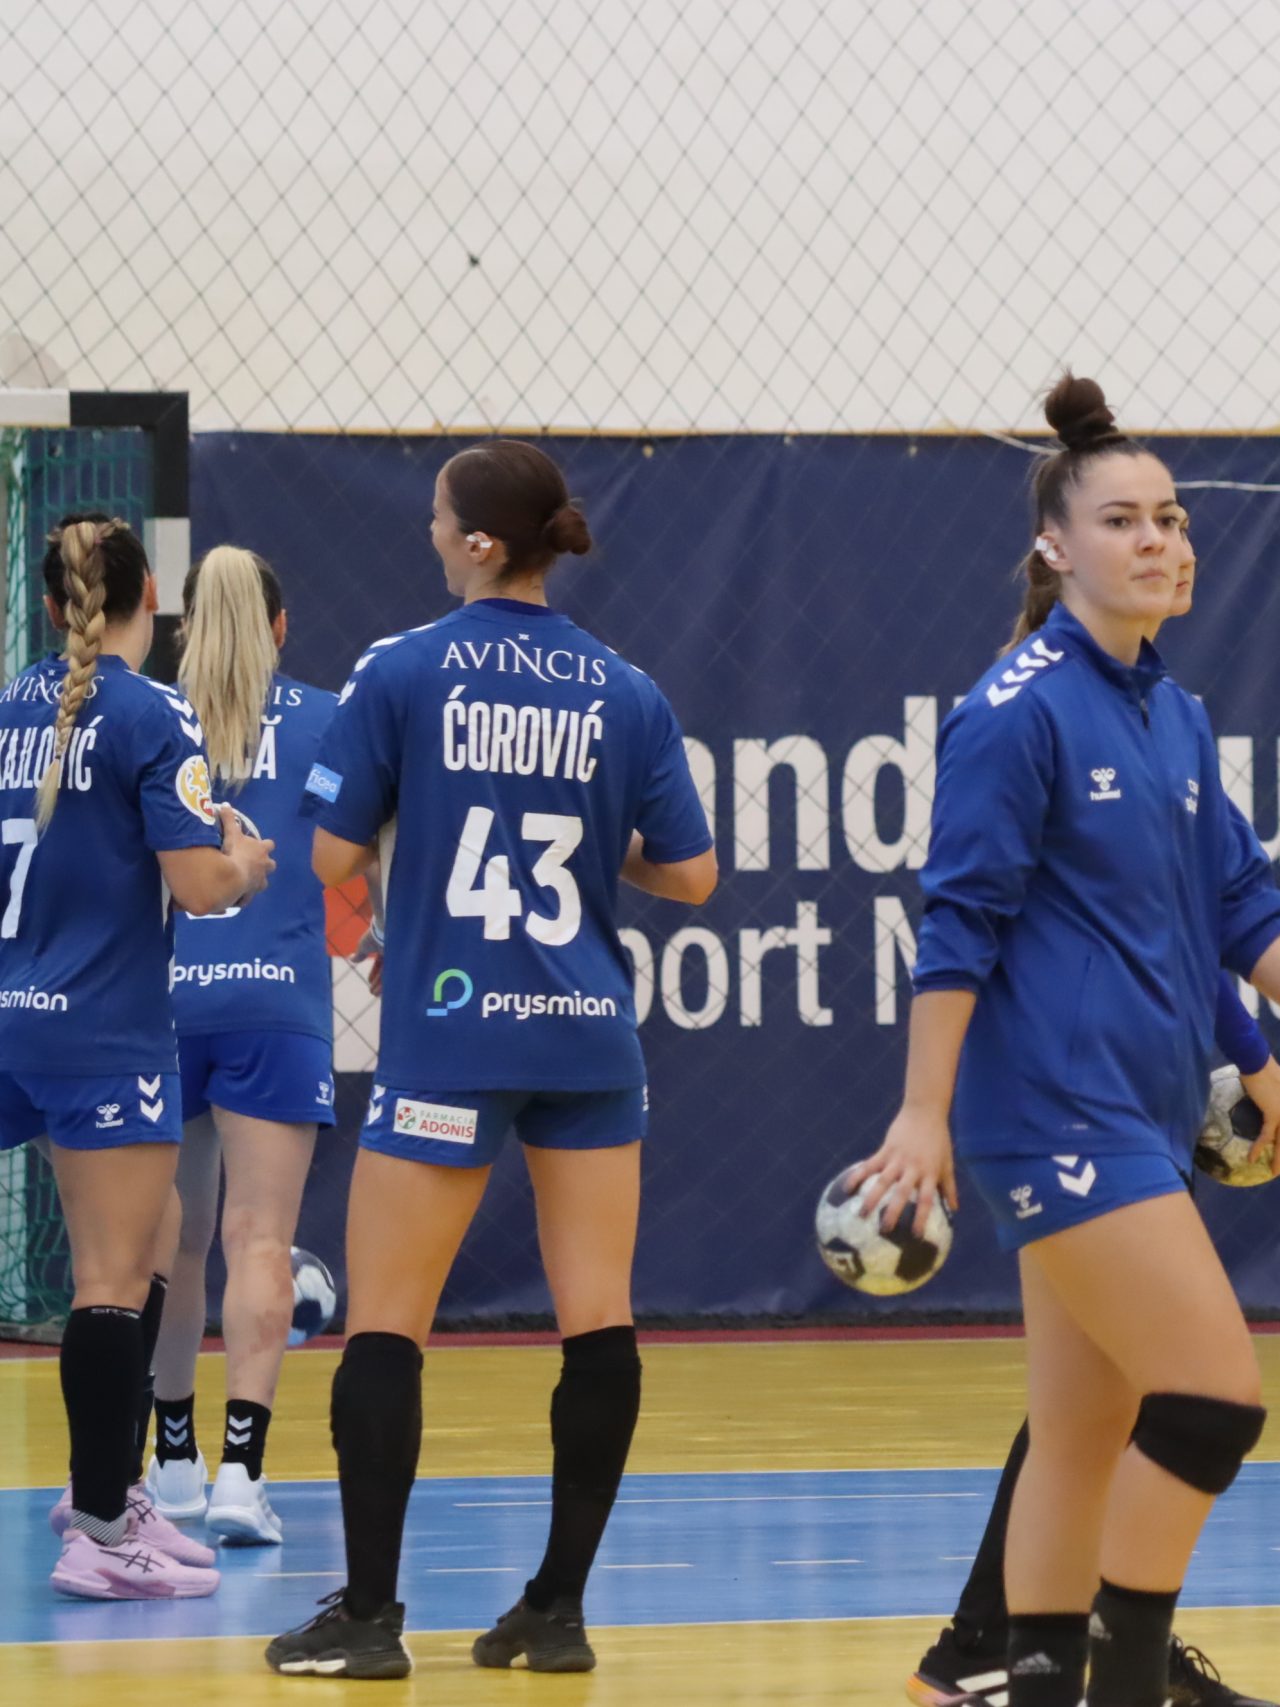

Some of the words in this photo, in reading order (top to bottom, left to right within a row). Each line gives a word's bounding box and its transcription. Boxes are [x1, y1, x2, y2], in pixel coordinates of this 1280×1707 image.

[440, 637, 606, 686] AVINCIS
[0, 674, 104, 704] AVINCS
[444, 685, 604, 783] ĆOROVIĆ
[2, 818, 38, 938] 7
[446, 806, 583, 946] 43
[172, 957, 295, 987] prysmian
[0, 986, 68, 1011] smian
[482, 991, 616, 1020] prysmian
[419, 1119, 475, 1138] ADONIS
